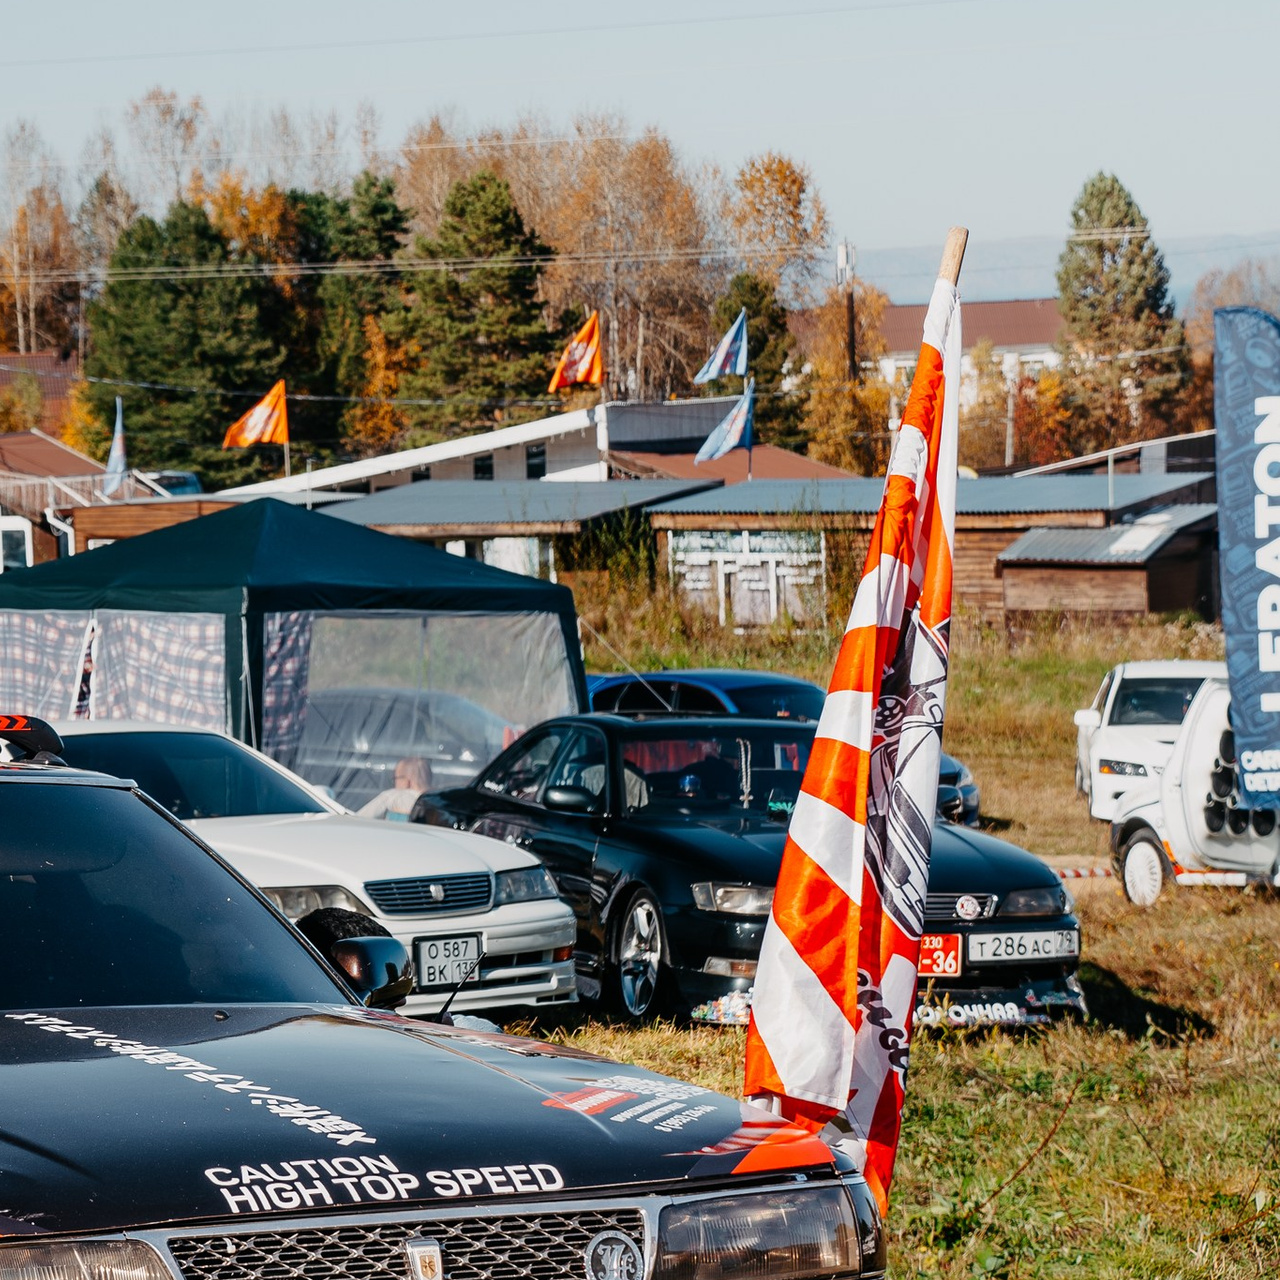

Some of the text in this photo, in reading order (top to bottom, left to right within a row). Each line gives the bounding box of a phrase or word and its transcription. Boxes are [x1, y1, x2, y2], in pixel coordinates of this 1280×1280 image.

[922, 935, 943, 949] 330
[204, 1155, 400, 1186] CAUTION
[220, 1163, 565, 1214] HIGH TOP SPEED
